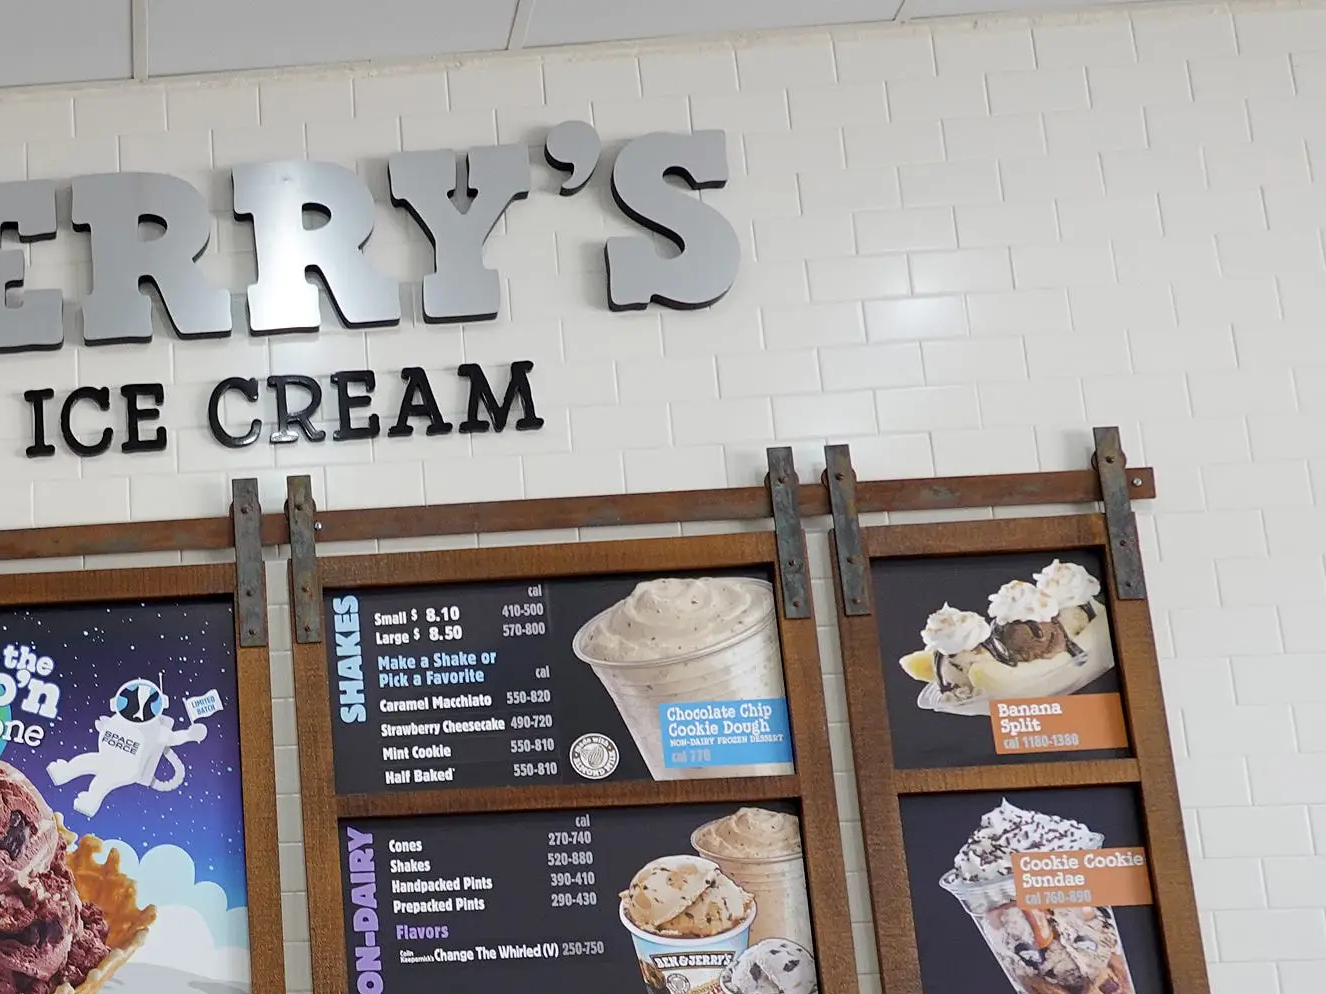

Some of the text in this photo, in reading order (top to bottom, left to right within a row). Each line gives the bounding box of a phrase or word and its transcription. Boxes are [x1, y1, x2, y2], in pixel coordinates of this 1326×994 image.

[25, 382, 167, 459] ICE
[207, 359, 544, 449] CREAM
[3, 645, 54, 676] the
[333, 595, 367, 724] SHAKES
[378, 652, 496, 670] Make a Shake or
[379, 669, 484, 687] Pick a Favorite
[380, 690, 550, 712] Caramel Macchiato 550-820
[998, 702, 1062, 717] Banana
[667, 703, 771, 721] Chocolate Chip
[669, 720, 770, 737] Cookie Dough
[1000, 718, 1041, 735] Split
[102, 738, 137, 755] FORCE
[104, 731, 140, 748] SPACE
[1020, 852, 1144, 871] Cookie Cookie
[1022, 873, 1085, 888] Sundae
[396, 925, 448, 939] Flavors
